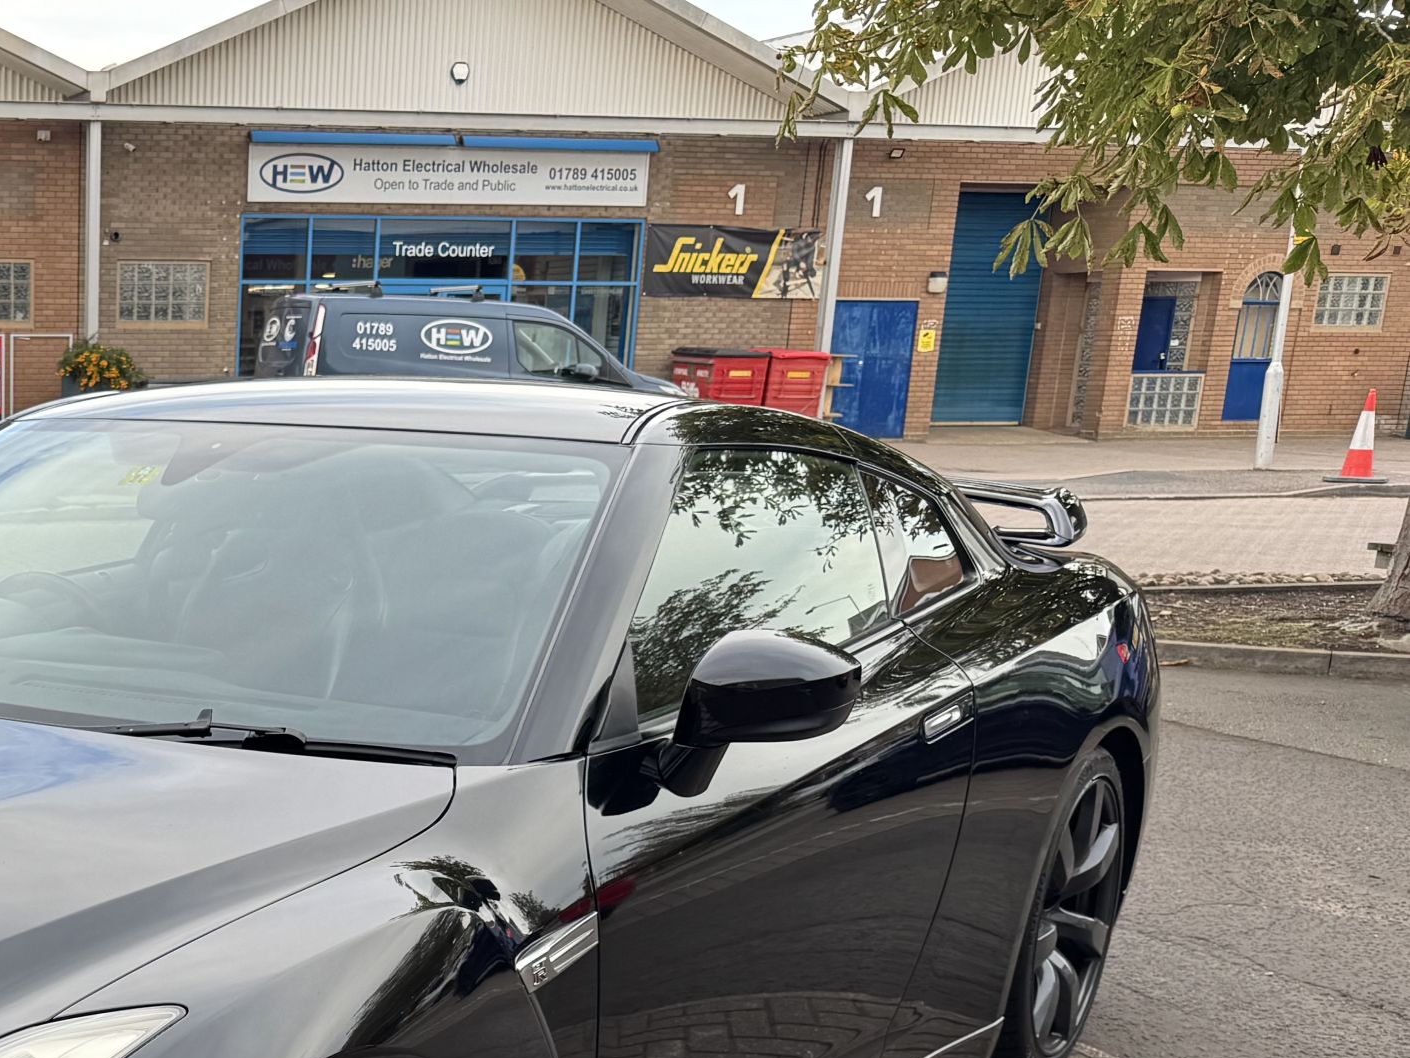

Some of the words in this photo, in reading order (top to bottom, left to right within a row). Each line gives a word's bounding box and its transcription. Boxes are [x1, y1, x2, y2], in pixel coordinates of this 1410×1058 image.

[353, 158, 398, 173] Hatton
[402, 159, 465, 174] Electrical
[469, 160, 538, 175] Wholesale
[549, 167, 587, 181] 01789
[591, 168, 637, 182] 415005
[374, 178, 405, 192] Open
[408, 179, 419, 191] to
[422, 179, 454, 191] Trade
[457, 179, 479, 191] and
[482, 180, 516, 192] Public
[545, 183, 638, 192] www.hattonelectrical.co.uk
[727, 183, 747, 216] 1
[864, 185, 882, 218] 1
[393, 241, 434, 257] Trade
[438, 242, 495, 258] Counter
[691, 274, 745, 285] WORKWEAR
[356, 322, 393, 335] 01789
[352, 338, 397, 351] 415005
